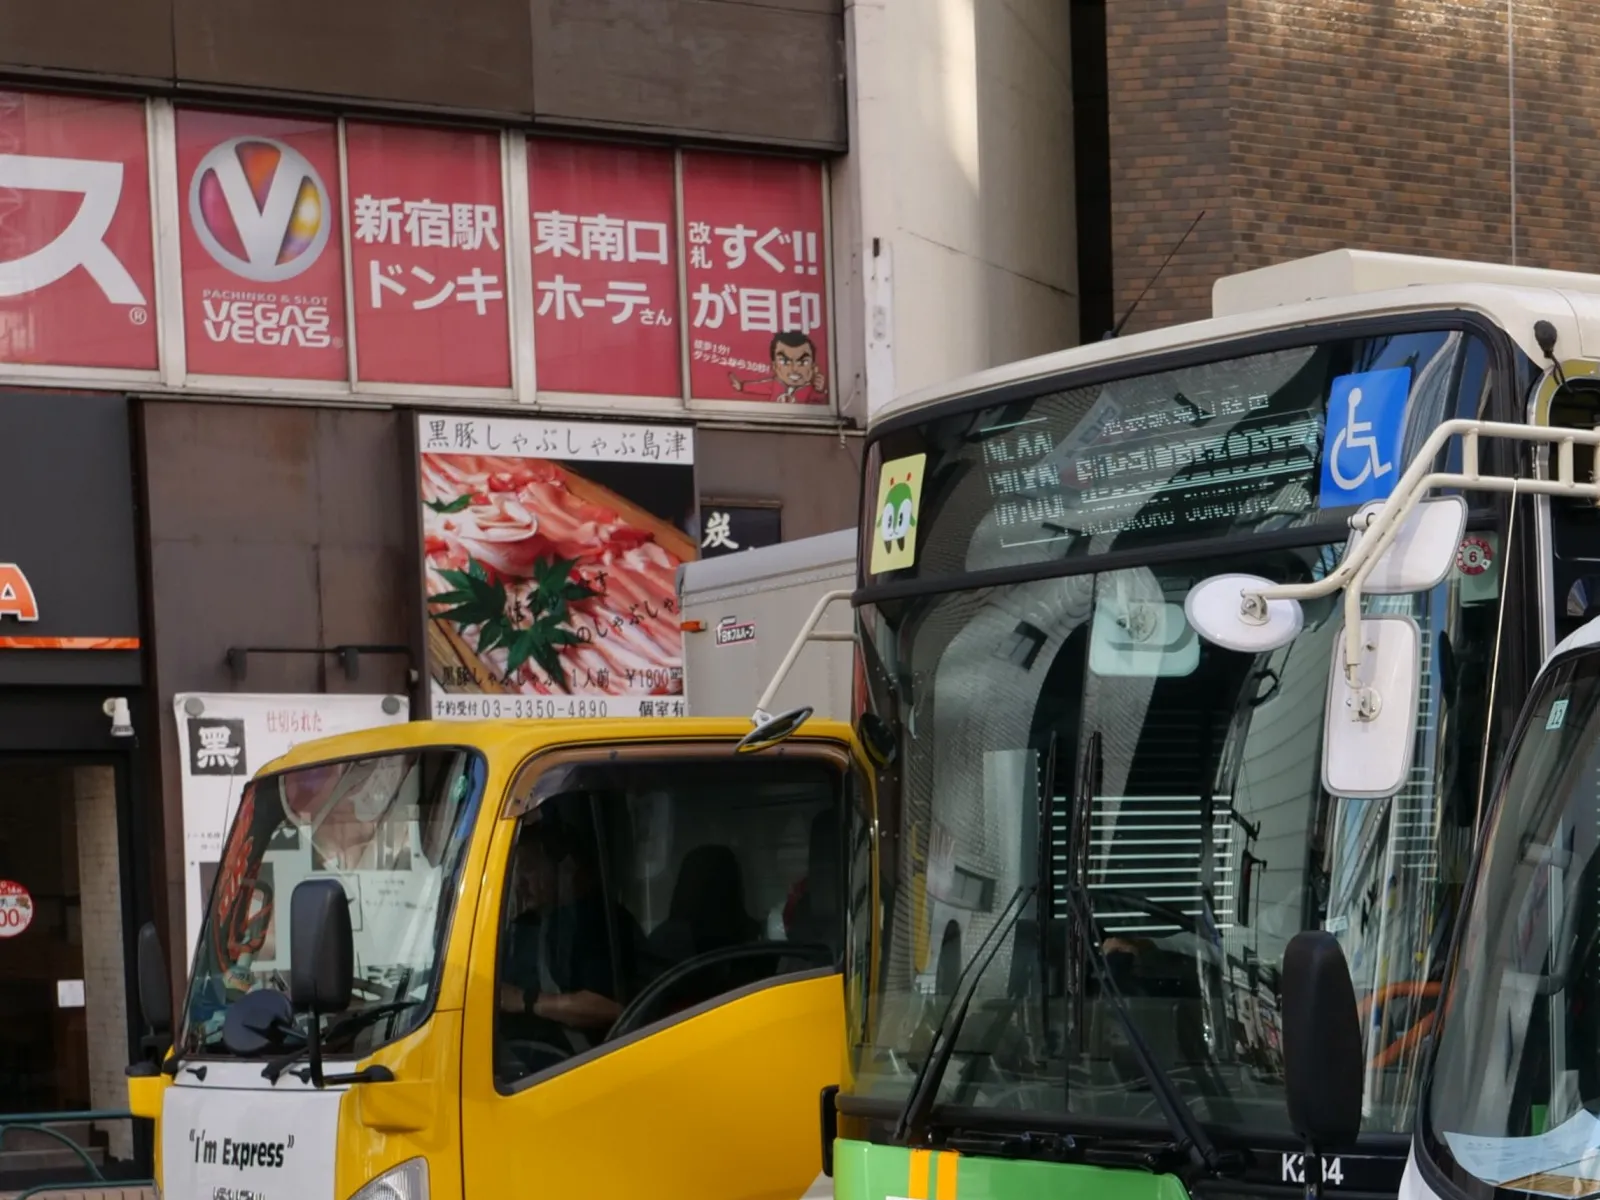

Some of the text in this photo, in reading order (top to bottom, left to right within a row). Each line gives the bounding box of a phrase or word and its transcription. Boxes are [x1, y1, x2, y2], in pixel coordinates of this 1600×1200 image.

[354, 195, 817, 275] 新宿駅 東南口 改札 すぐ!!
[202, 289, 277, 303] PACHINKO
[294, 295, 329, 306] SLOT
[203, 300, 330, 331] VEGAS
[370, 260, 503, 315] ドンキ
[692, 283, 821, 335] が目印
[204, 319, 331, 348] VEGAS
[426, 419, 689, 461] 黒豚しゃぶしゃぶ島津
[481, 700, 608, 719] 03-3350-4890
[197, 726, 241, 769] 黒
